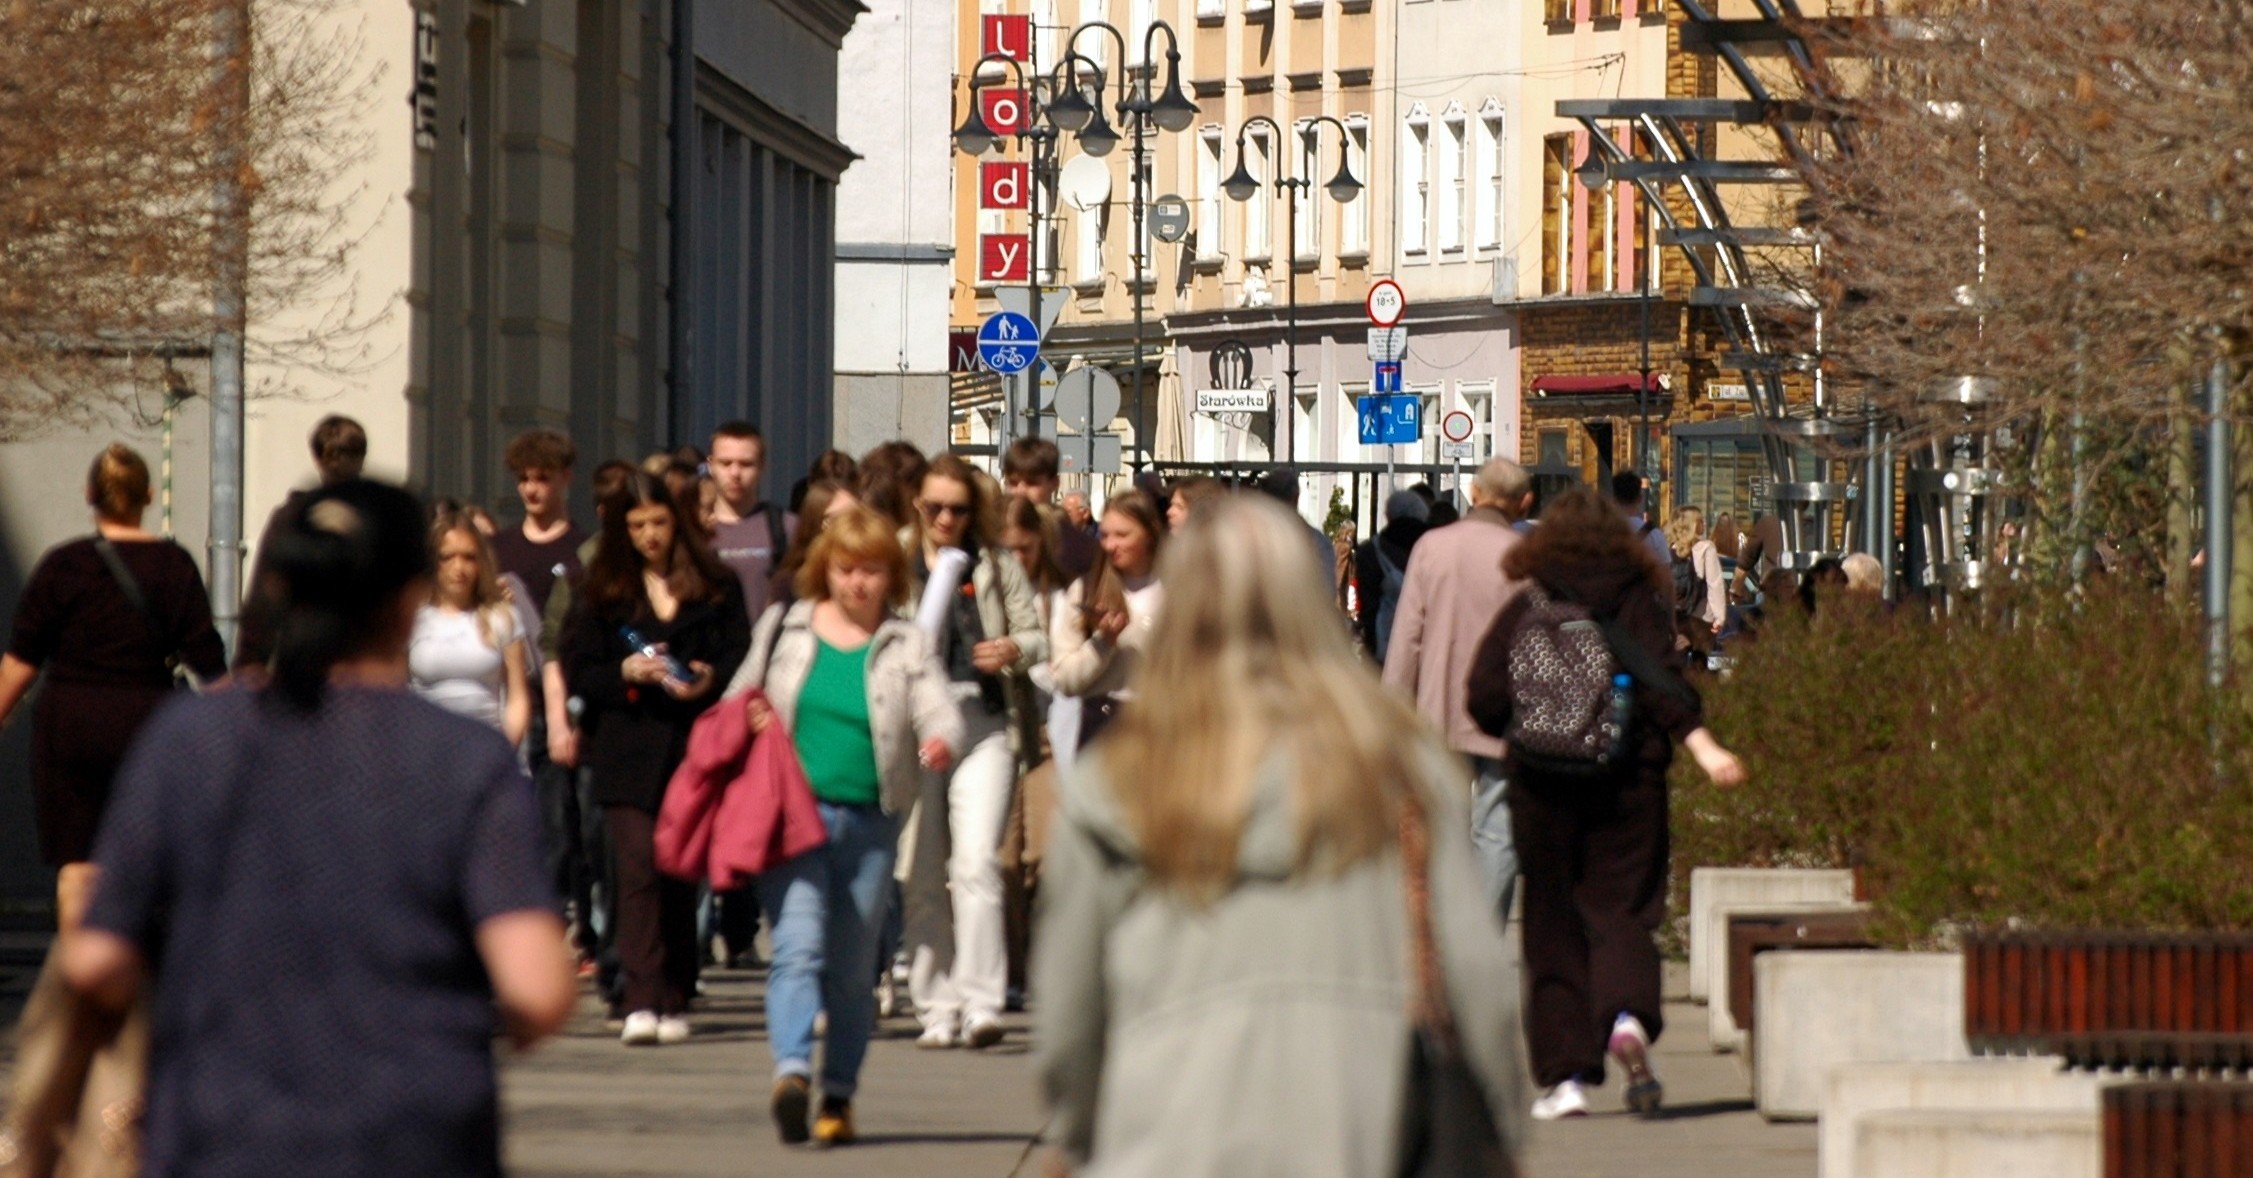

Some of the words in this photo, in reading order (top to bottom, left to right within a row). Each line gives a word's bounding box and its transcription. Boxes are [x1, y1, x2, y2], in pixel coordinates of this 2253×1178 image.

[992, 20, 1019, 278] lody
[957, 344, 984, 372] M
[1200, 394, 1264, 406] Starówka
